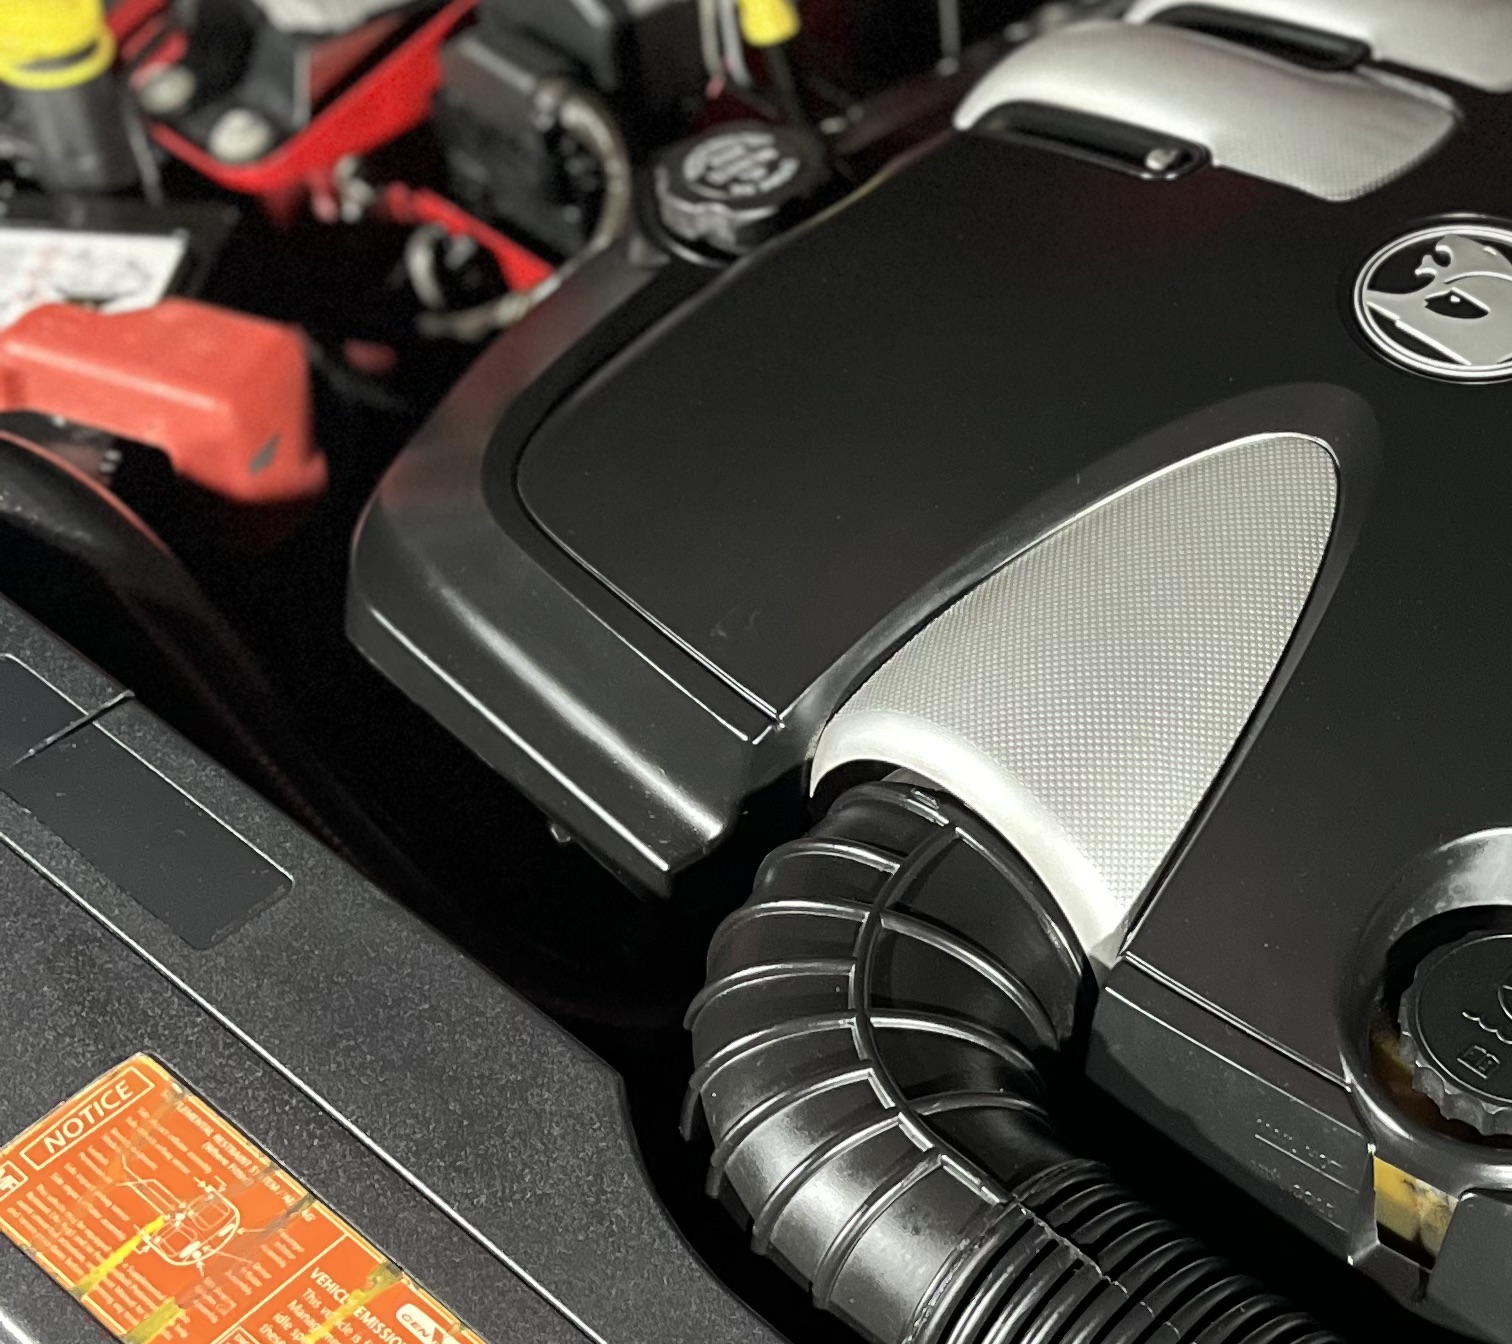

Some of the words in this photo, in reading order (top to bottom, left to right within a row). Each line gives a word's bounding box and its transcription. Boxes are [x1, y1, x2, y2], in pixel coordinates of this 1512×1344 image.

[43, 1079, 134, 1154] NOTICE
[308, 1268, 359, 1310] VEHICL
[272, 1311, 295, 1331] idle
[300, 1288, 324, 1308] This
[319, 1304, 356, 1335] vecle
[350, 1332, 363, 1344] is
